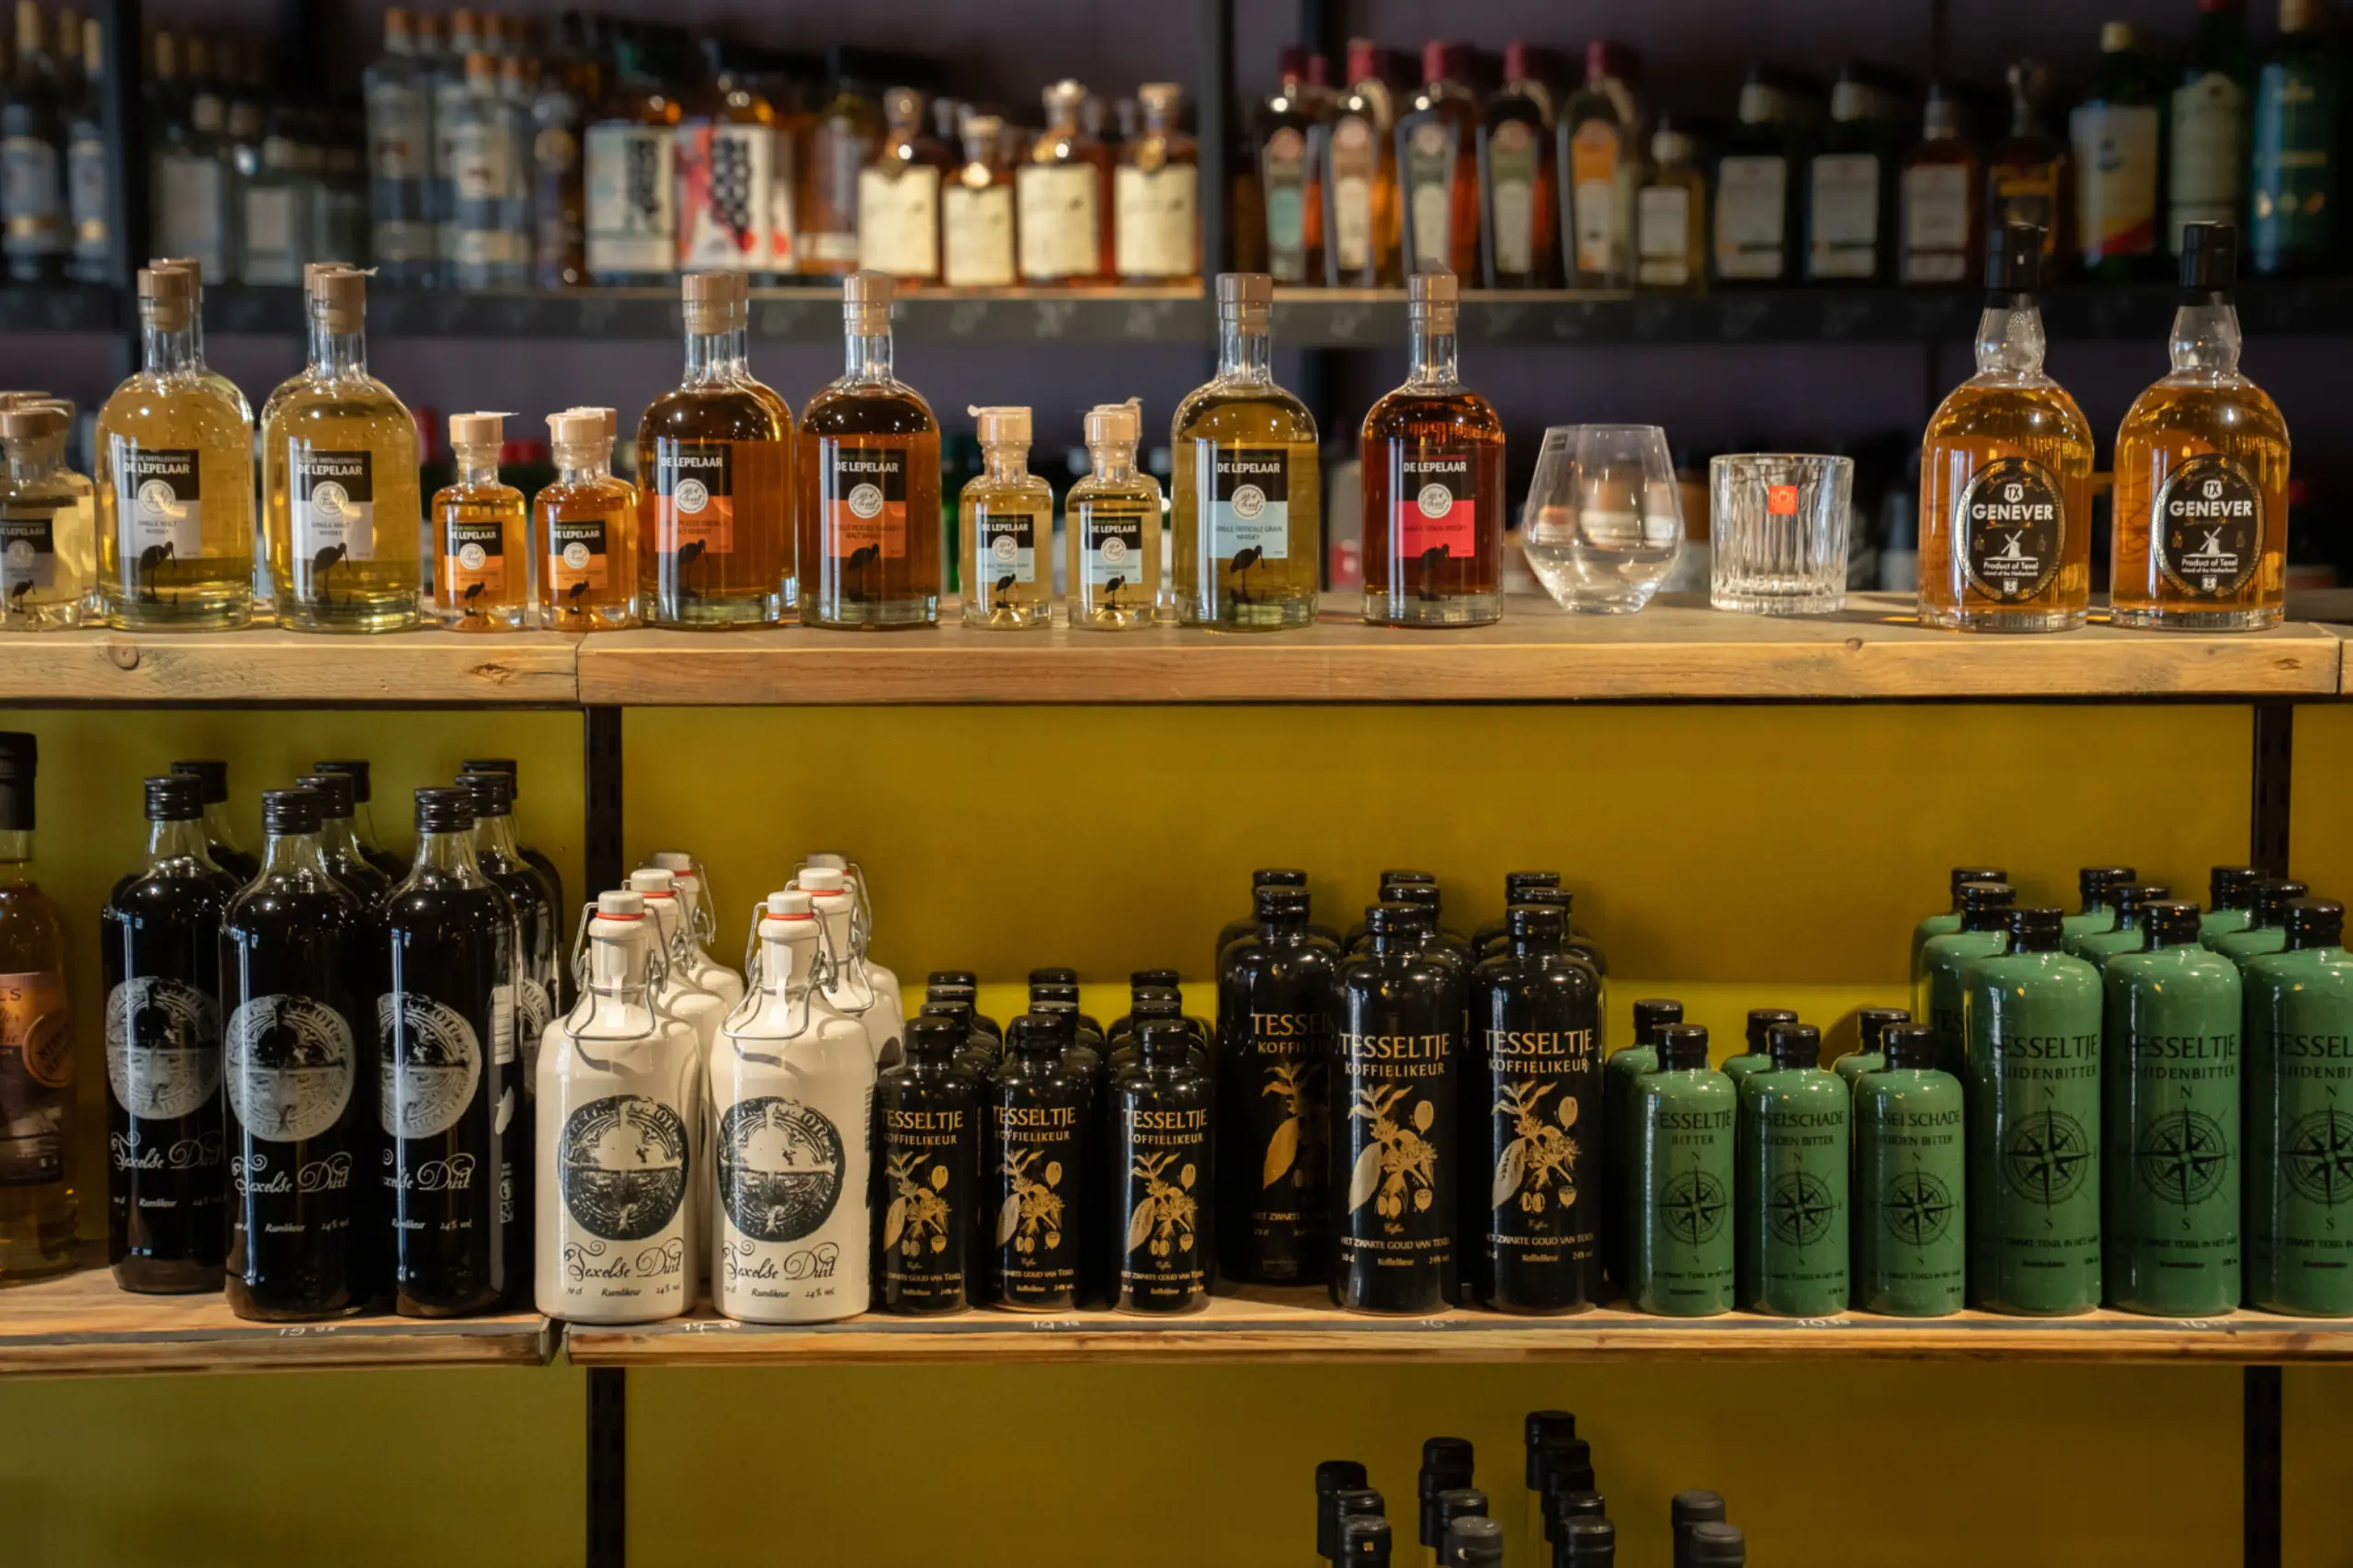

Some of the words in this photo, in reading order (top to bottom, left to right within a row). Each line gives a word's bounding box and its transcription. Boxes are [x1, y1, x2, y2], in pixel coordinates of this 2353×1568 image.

[124, 462, 137, 473] DE
[138, 463, 190, 474] LEPELAAR
[661, 457, 672, 467] DE
[674, 457, 722, 467] LEPELAAR
[835, 461, 847, 472] DE
[848, 461, 898, 472] LEPELAAR
[1217, 462, 1230, 473] DE
[1232, 462, 1280, 473] LEPELAAR
[1404, 462, 1415, 472] DE
[1417, 461, 1467, 472] LEPELAAR
[298, 464, 310, 474] DE
[312, 464, 362, 475] LEPELAAR
[2207, 483, 2219, 495] TX
[1972, 504, 2053, 520] GENEVER
[2169, 500, 2252, 517] GENEVER
[992, 523, 1028, 532] LEPELAAR
[1100, 525, 1137, 534] LEPELAAR
[459, 530, 496, 540] LEPELAAR
[563, 529, 599, 540] LEPELAAR
[1984, 562, 2010, 571] Product
[2011, 561, 2020, 570] of
[2182, 558, 2210, 567] Product
[2211, 558, 2219, 567] of
[1339, 1033, 1450, 1061] TESSELTJE
[1483, 1028, 1593, 1056] TESSELTJE
[1988, 1034, 2097, 1061] ESSELTJE
[2120, 1034, 2236, 1061] TESSELTJE
[1345, 1062, 1445, 1077] KOFFIELIKEUR
[1488, 1058, 1588, 1074] KOFFIELIKEUR
[1987, 1065, 2097, 1081] UIDENBITTER
[2180, 1085, 2192, 1098] N
[881, 1108, 963, 1131] TESSELTJE
[993, 1105, 1075, 1128] TESSELTJE
[1122, 1108, 1208, 1131] TESSELTJE
[1654, 1109, 1732, 1131] ESSELTJE
[1671, 1134, 1715, 1145] BITTER
[1802, 1134, 1834, 1146] BITTER
[1921, 1134, 1952, 1146] BITTER
[2182, 1217, 2191, 1231] S
[1387, 1240, 1414, 1250] GOUD
[1415, 1239, 1432, 1249] VAN
[1497, 1233, 1529, 1245] ZWARTE
[1531, 1235, 1559, 1246] GOUD
[1560, 1233, 1575, 1245] VAN
[563, 1240, 631, 1282] Texelse
[722, 1240, 779, 1280] Texelse
